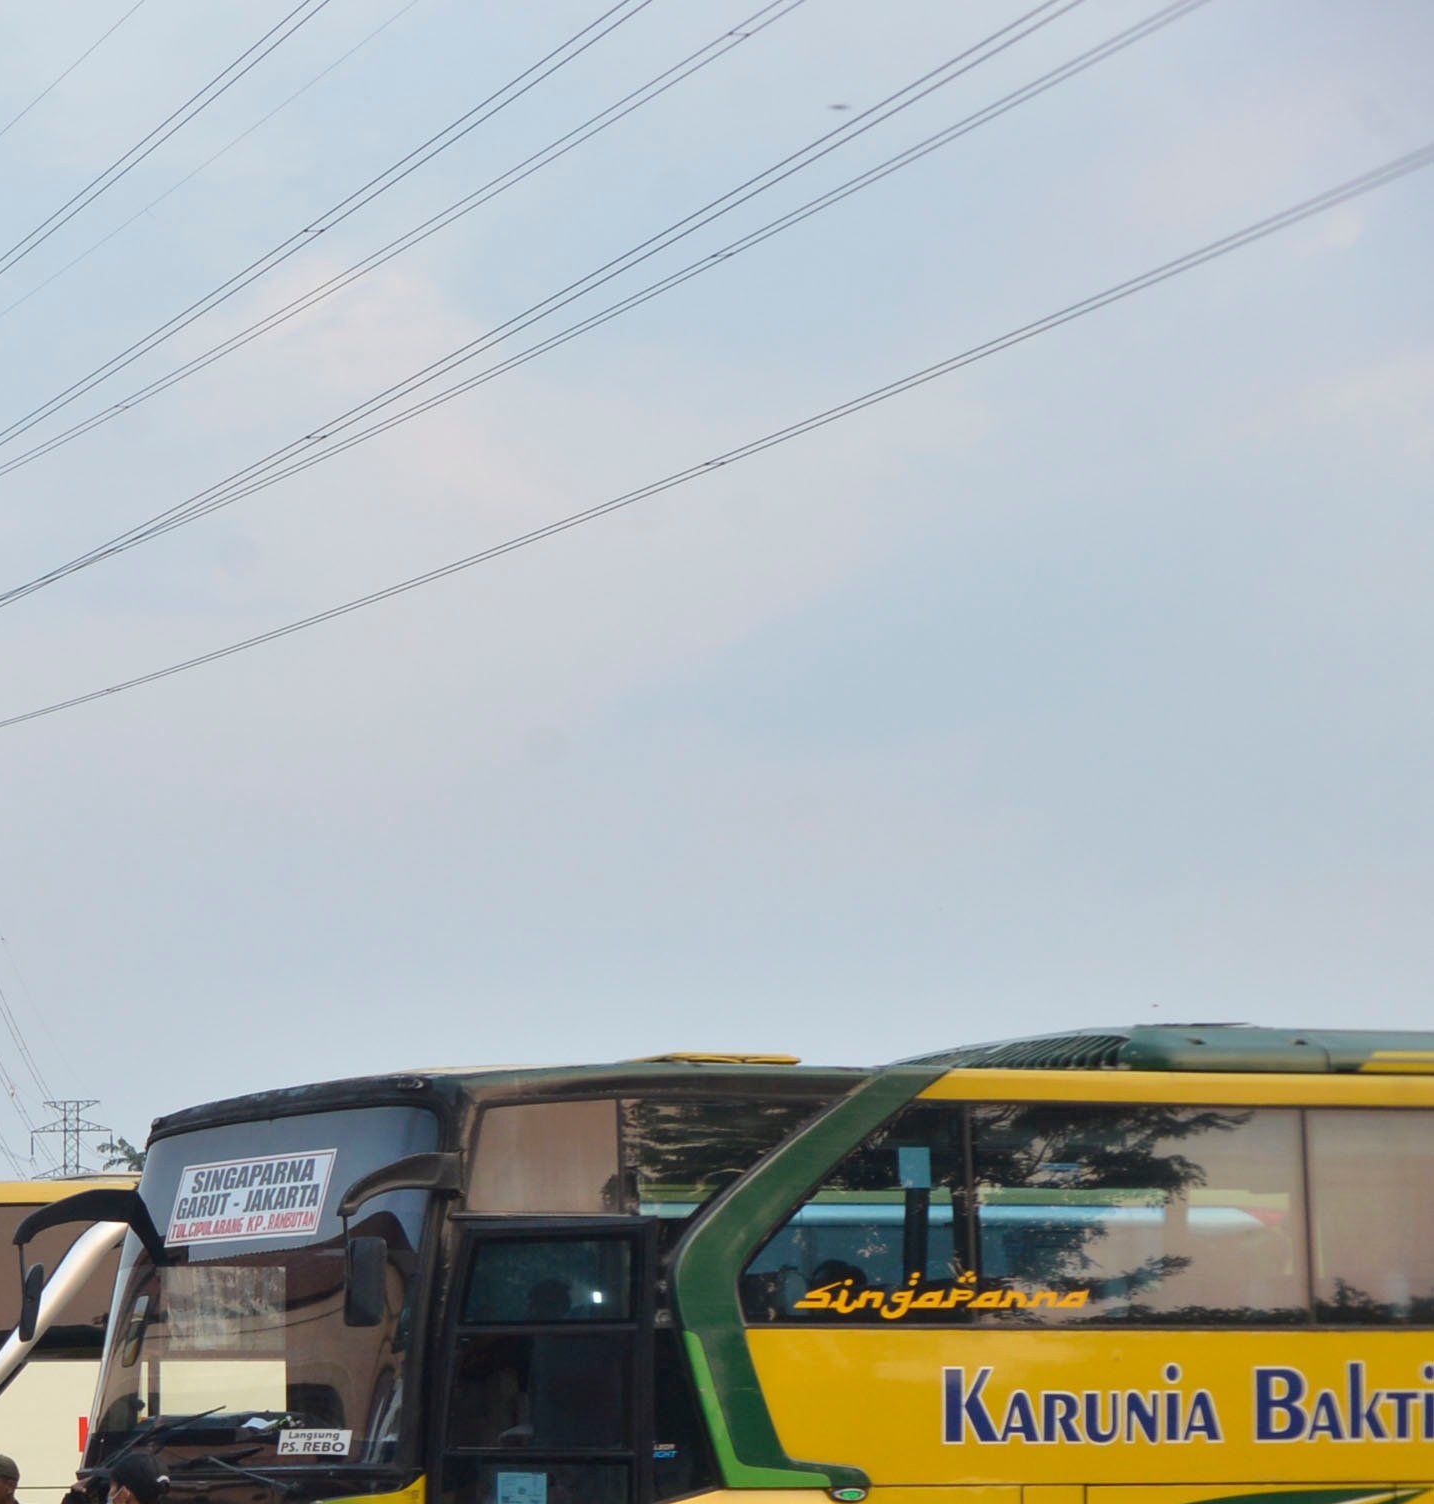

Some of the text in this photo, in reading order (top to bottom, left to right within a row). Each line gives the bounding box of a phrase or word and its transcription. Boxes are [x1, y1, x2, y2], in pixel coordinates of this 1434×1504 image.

[192, 1158, 316, 1194] SINGAPARNA
[176, 1193, 231, 1220] GARUT
[242, 1183, 321, 1213] JAKARTA
[281, 1442, 345, 1452] PS. REBO
[288, 1431, 340, 1441] Langsung
